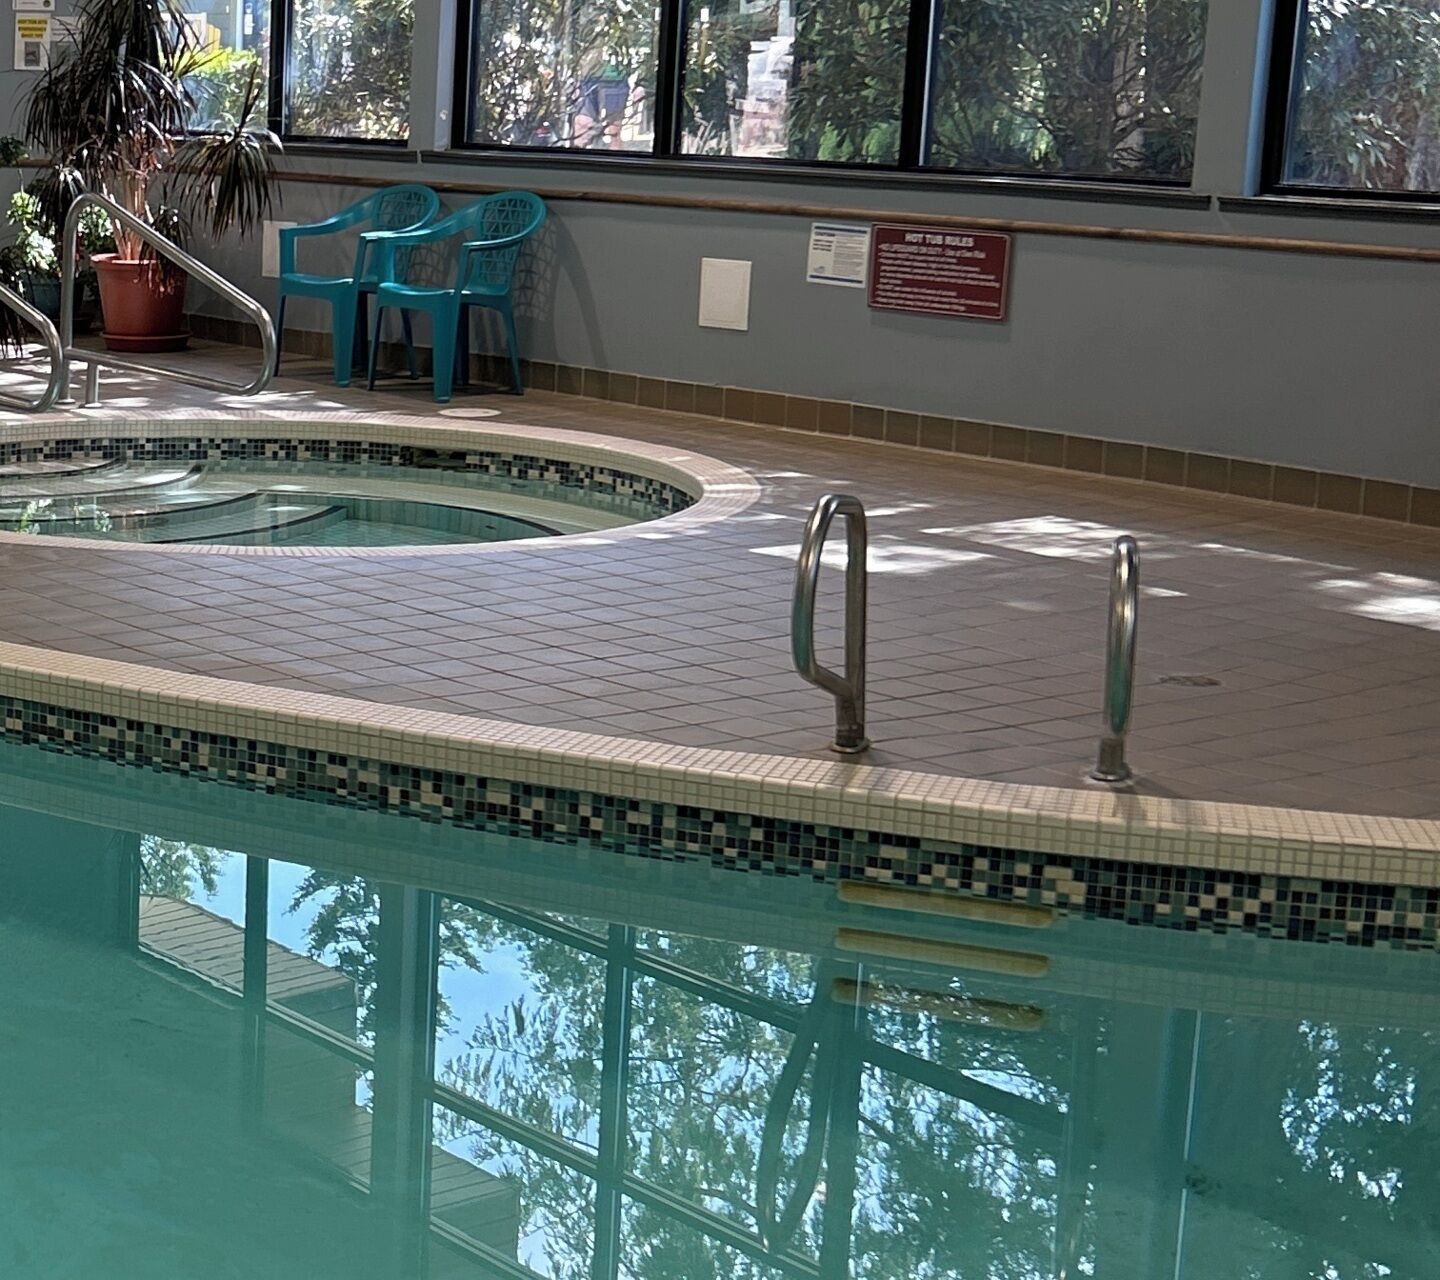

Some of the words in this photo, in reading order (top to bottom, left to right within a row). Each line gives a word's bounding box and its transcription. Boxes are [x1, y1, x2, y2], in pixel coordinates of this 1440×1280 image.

[905, 233, 923, 243] HOT
[925, 234, 943, 245] TUB
[945, 236, 974, 247] RULES
